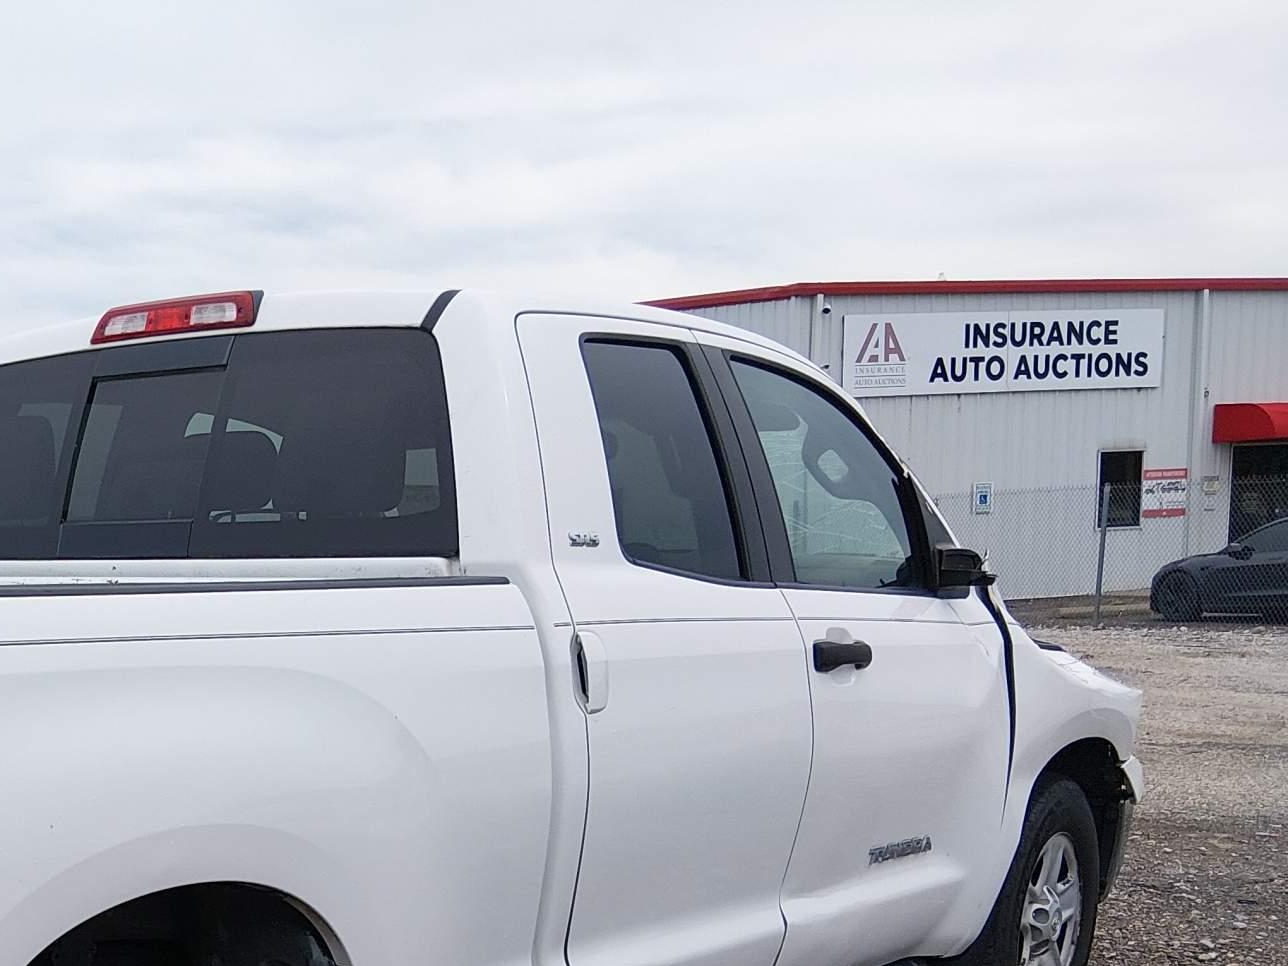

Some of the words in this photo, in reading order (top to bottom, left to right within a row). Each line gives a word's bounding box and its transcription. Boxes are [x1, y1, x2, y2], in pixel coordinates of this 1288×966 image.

[964, 320, 1119, 348] INSURANCE
[855, 367, 906, 375] INSURANCE
[929, 355, 1006, 383] AUTO
[1013, 351, 1149, 380] AUCTIONS
[855, 378, 873, 386] AUTO
[874, 377, 906, 385] AUCTIONS
